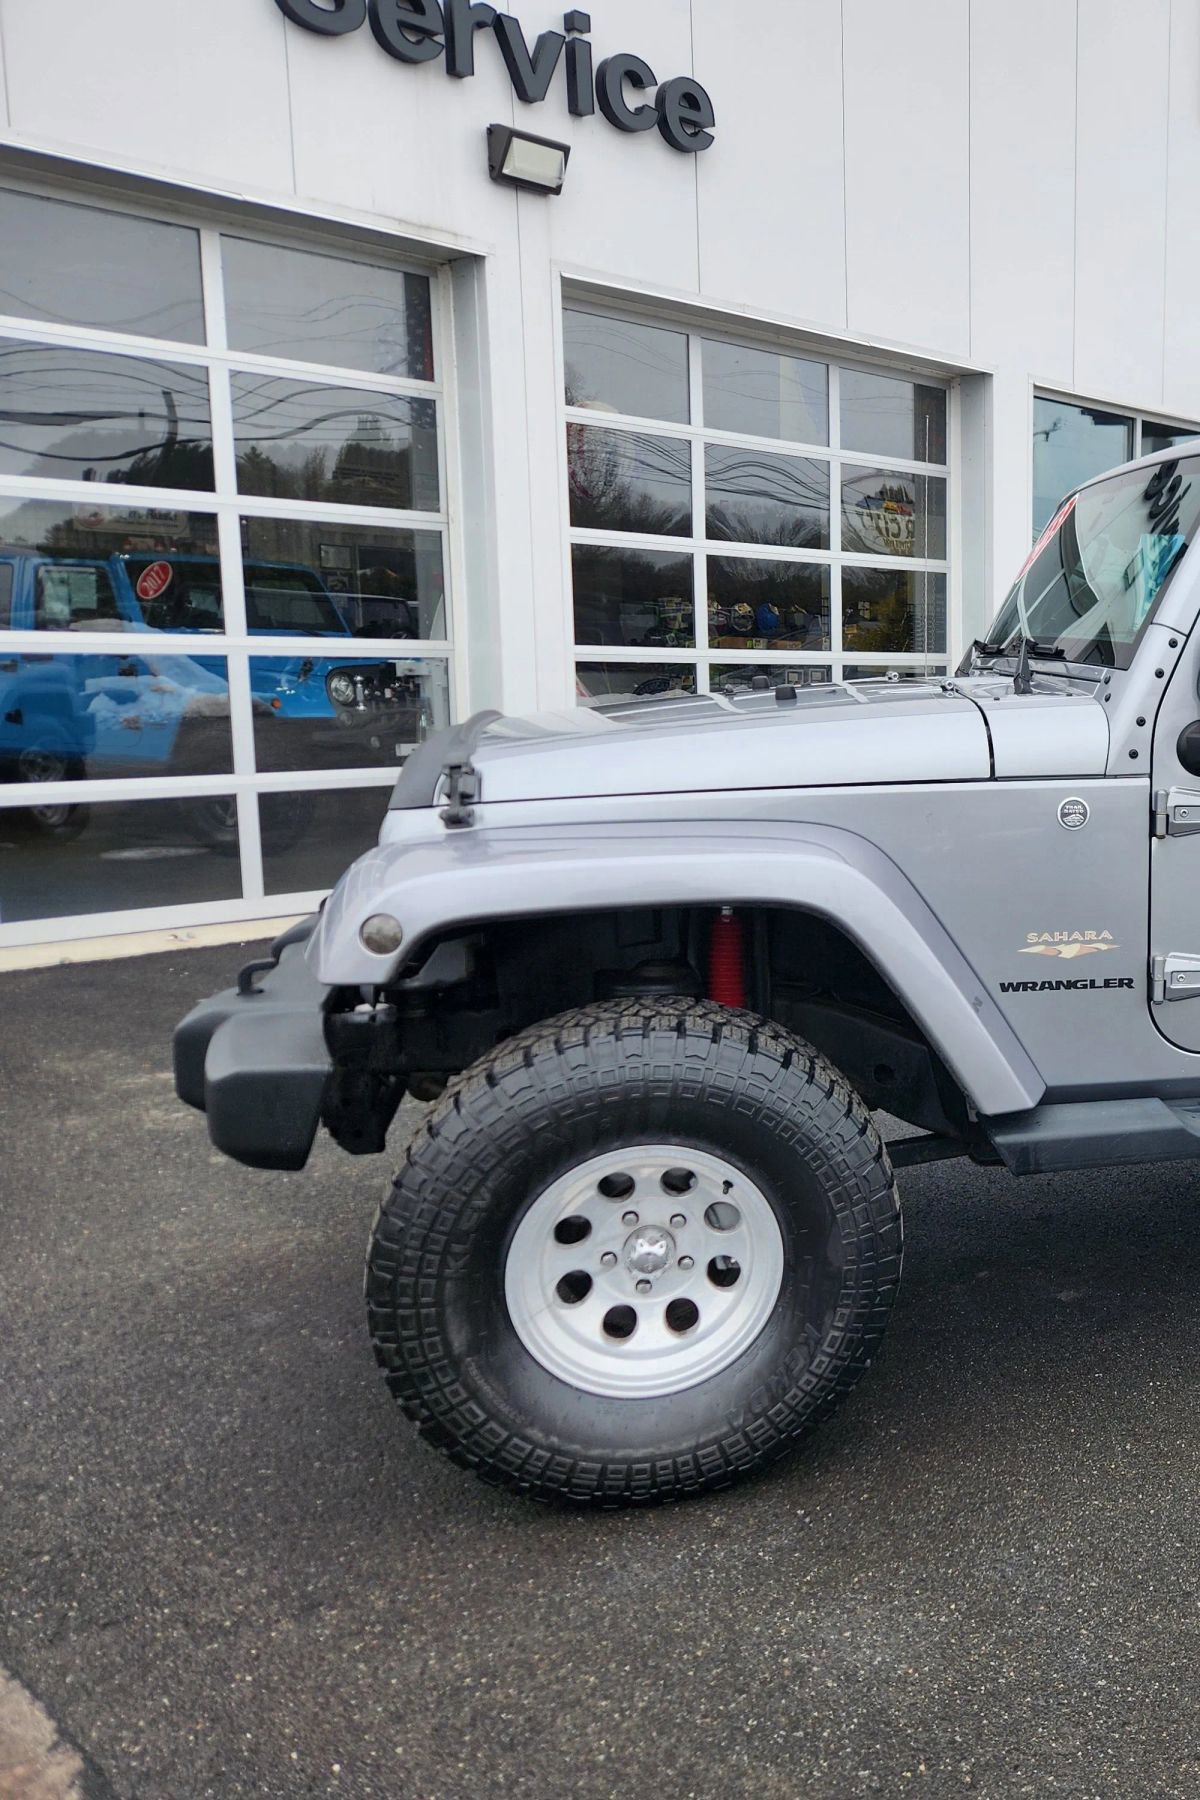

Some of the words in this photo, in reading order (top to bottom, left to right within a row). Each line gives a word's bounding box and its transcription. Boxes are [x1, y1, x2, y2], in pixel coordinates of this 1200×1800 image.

[141, 565, 166, 596] 2017
[1026, 929, 1113, 943] SAHARA
[999, 977, 1135, 993] WRANGLER
